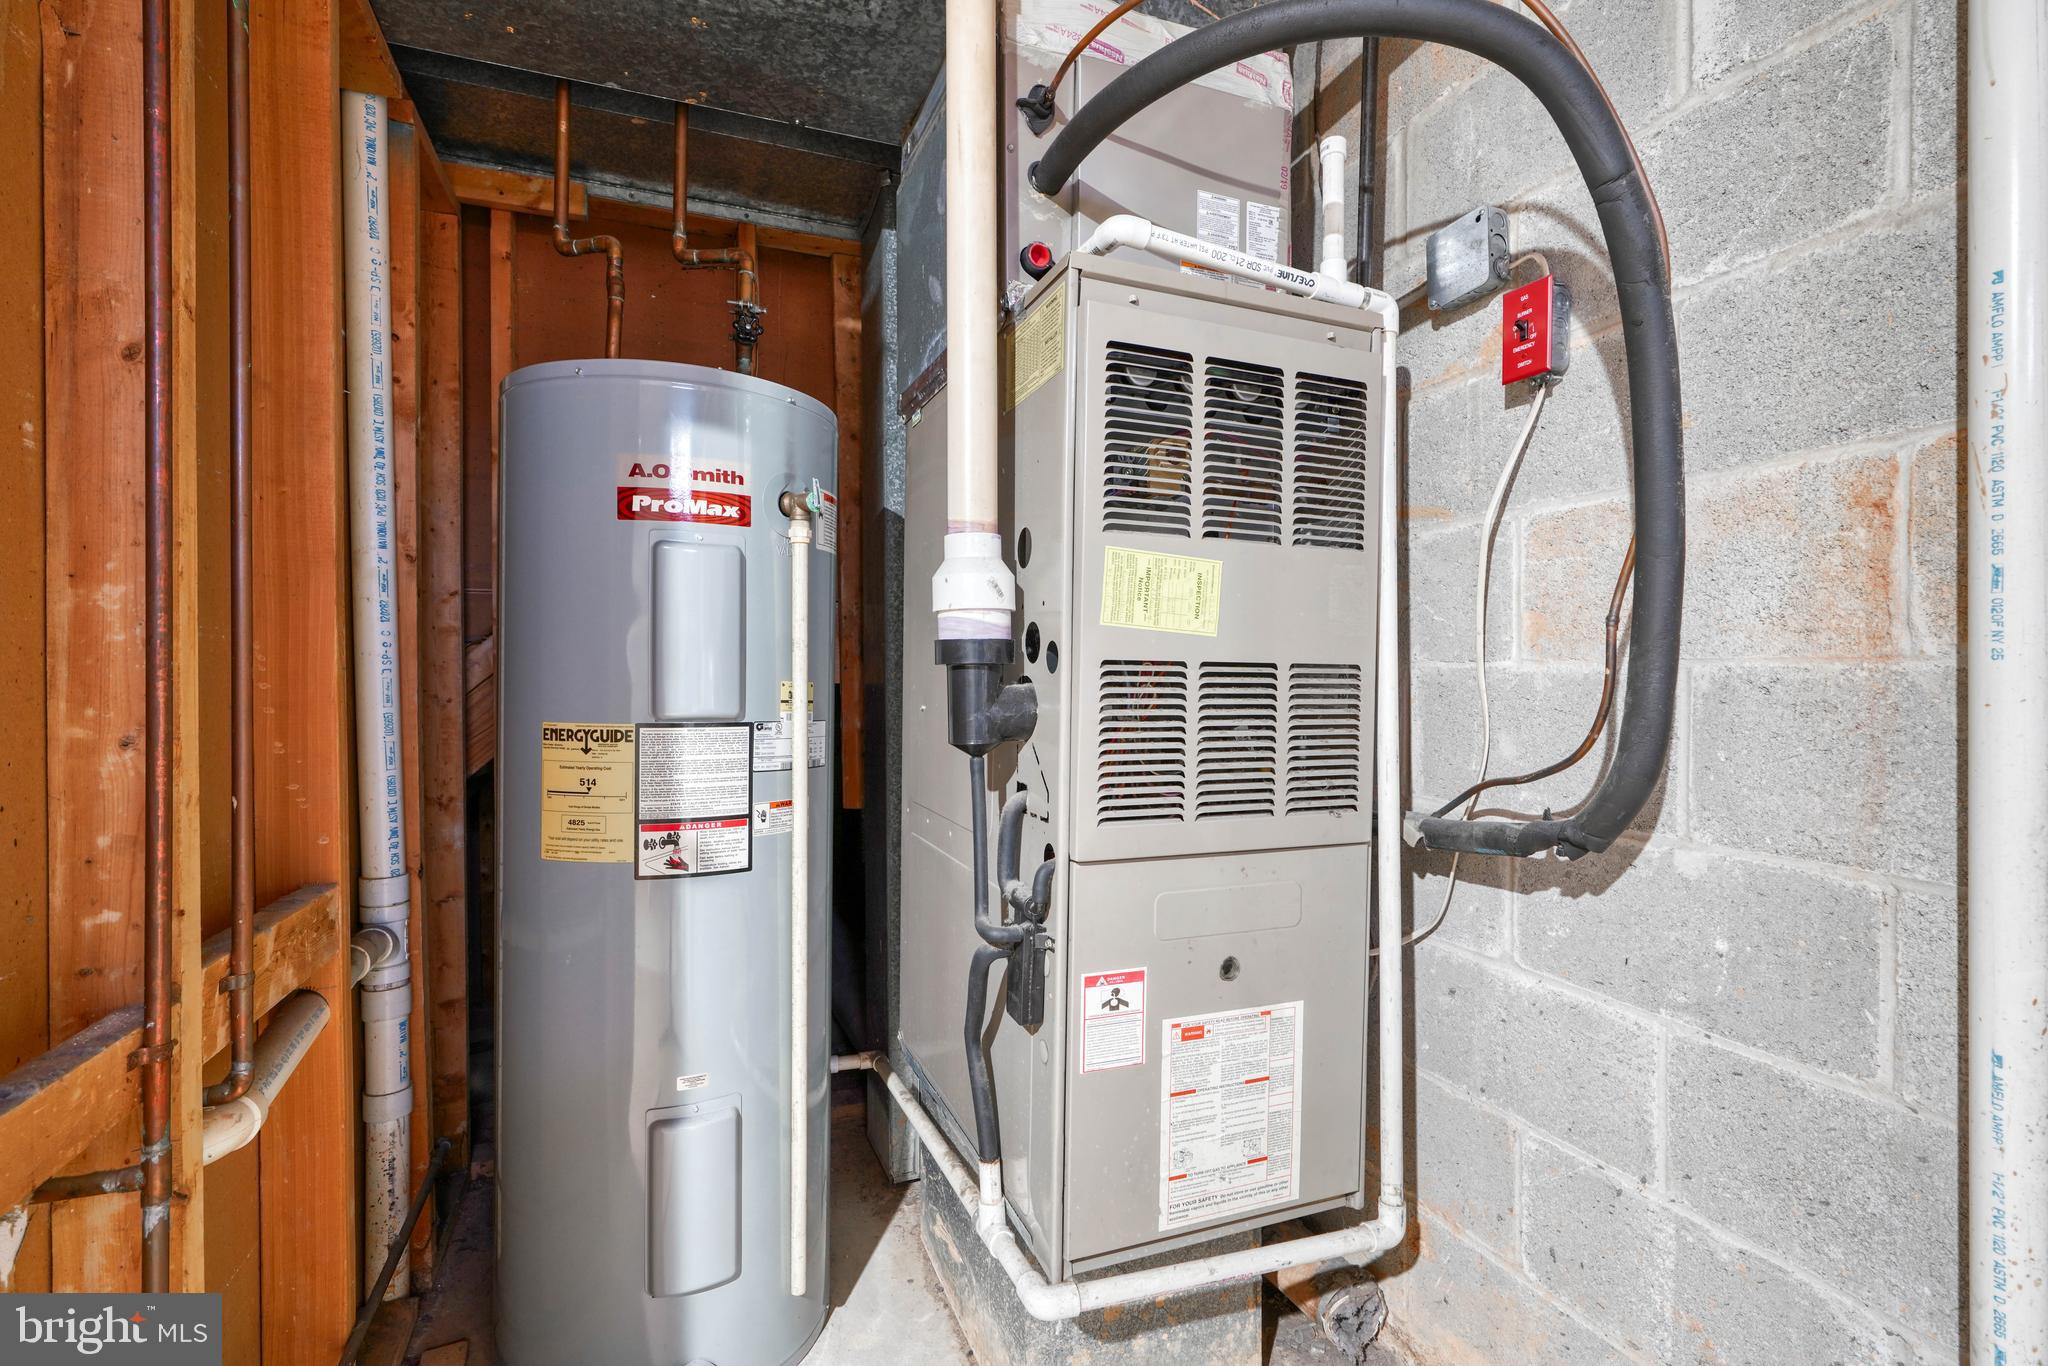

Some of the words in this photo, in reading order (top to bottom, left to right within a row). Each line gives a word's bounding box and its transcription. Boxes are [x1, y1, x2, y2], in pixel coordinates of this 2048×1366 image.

[365, 136, 377, 166] NATIONAL
[1211, 249, 1228, 262] 200
[1236, 257, 1246, 267] 21
[1247, 260, 1262, 272] SDR
[1991, 424, 2004, 447] PVC
[1991, 451, 2004, 472] 1120
[1992, 480, 2004, 508] ASTM
[632, 494, 740, 518] ProMax
[376, 520, 388, 549] NATIONAL
[1992, 528, 2004, 556] 2665
[1143, 566, 1152, 614] IMPORTANT
[1194, 572, 1203, 620] INSPECTION
[1991, 630, 2004, 644] NY
[1991, 648, 2004, 661] 25
[543, 728, 634, 743] ENERGYGUIDE
[580, 778, 596, 786] 514
[1198, 1195, 1218, 1204] SAFETY
[1992, 1207, 2006, 1230] PVC
[1992, 1234, 2006, 1257] 1120
[1993, 1260, 2006, 1292] ASTM
[1994, 1295, 2006, 1305] D
[1993, 1309, 2006, 1339] 2665
